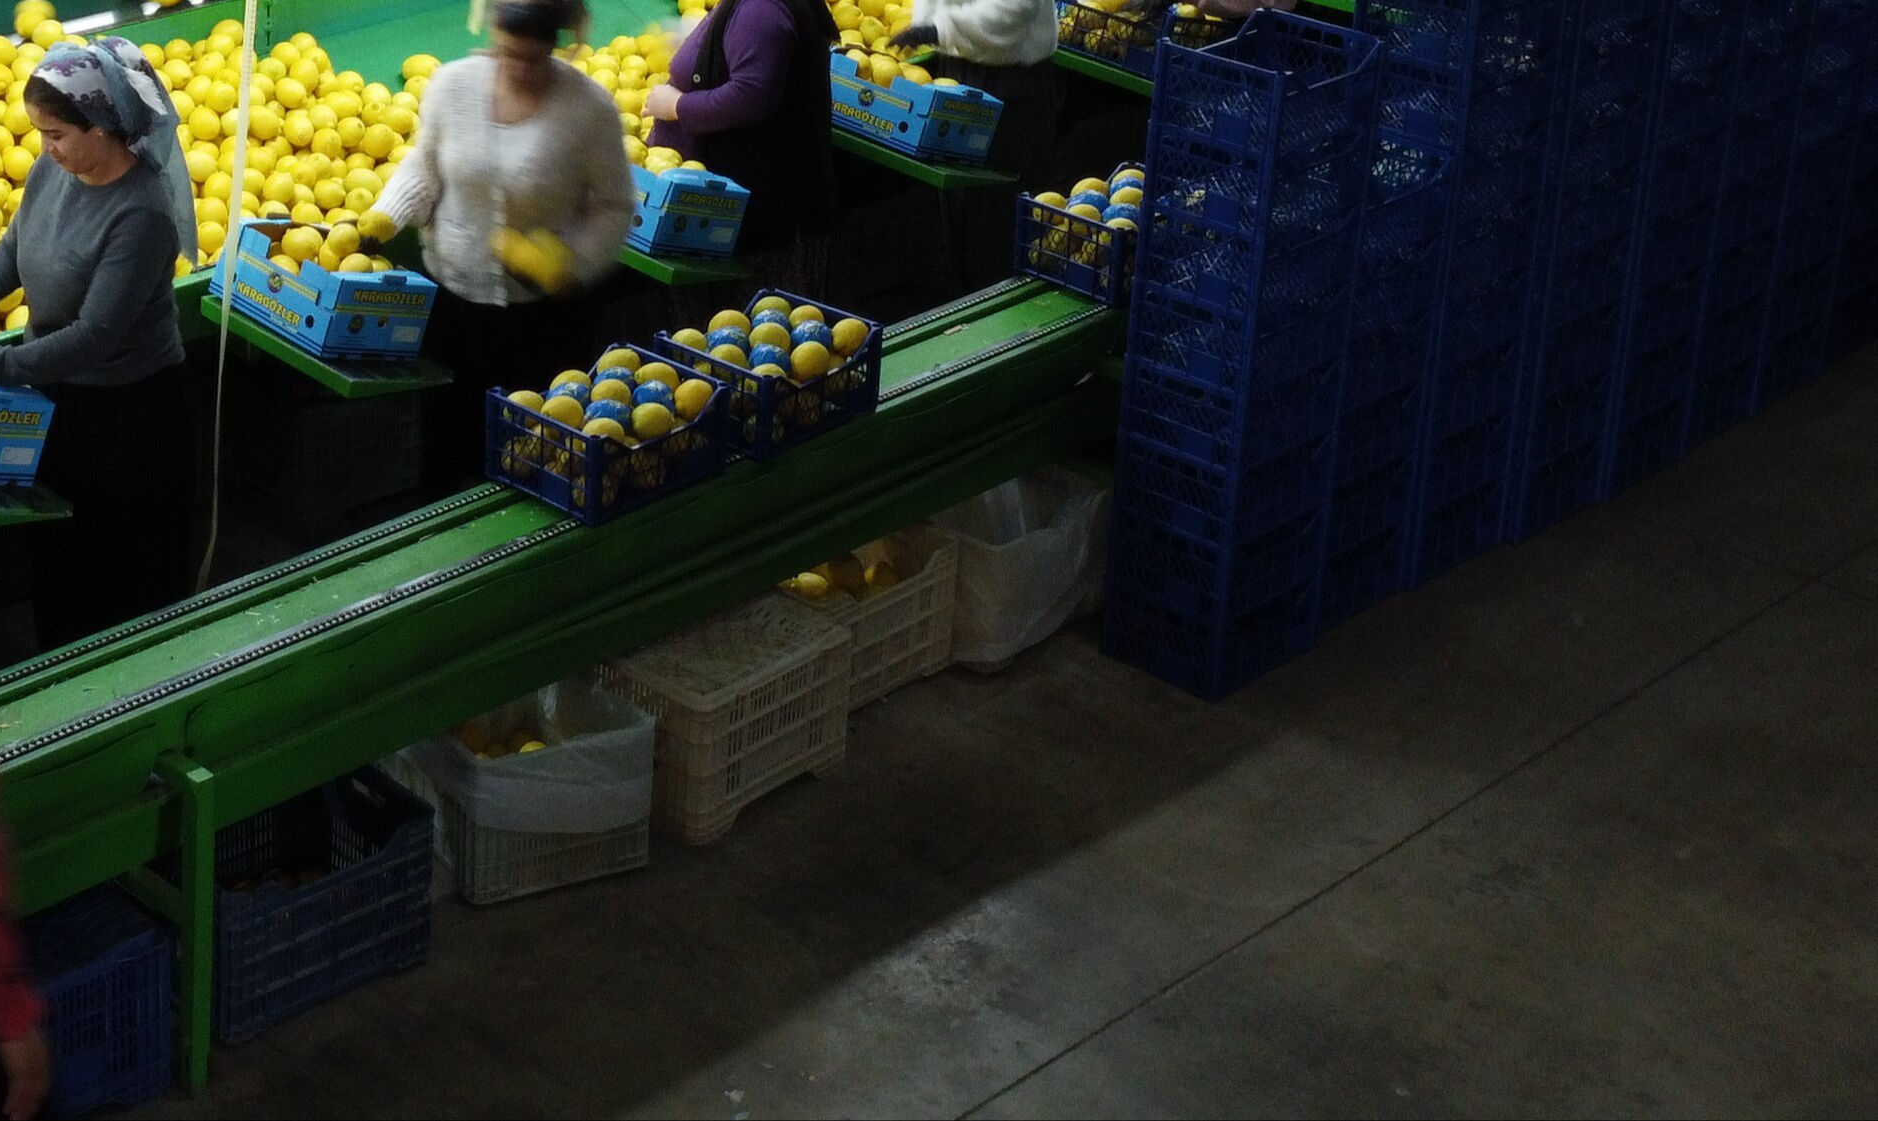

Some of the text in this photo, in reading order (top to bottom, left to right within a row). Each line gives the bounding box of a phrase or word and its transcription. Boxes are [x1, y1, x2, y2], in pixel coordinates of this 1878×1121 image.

[831, 100, 894, 133] ARAGÖZLER
[237, 281, 300, 326] KARAGÖZLER
[353, 289, 426, 306] KARAGÖZLER
